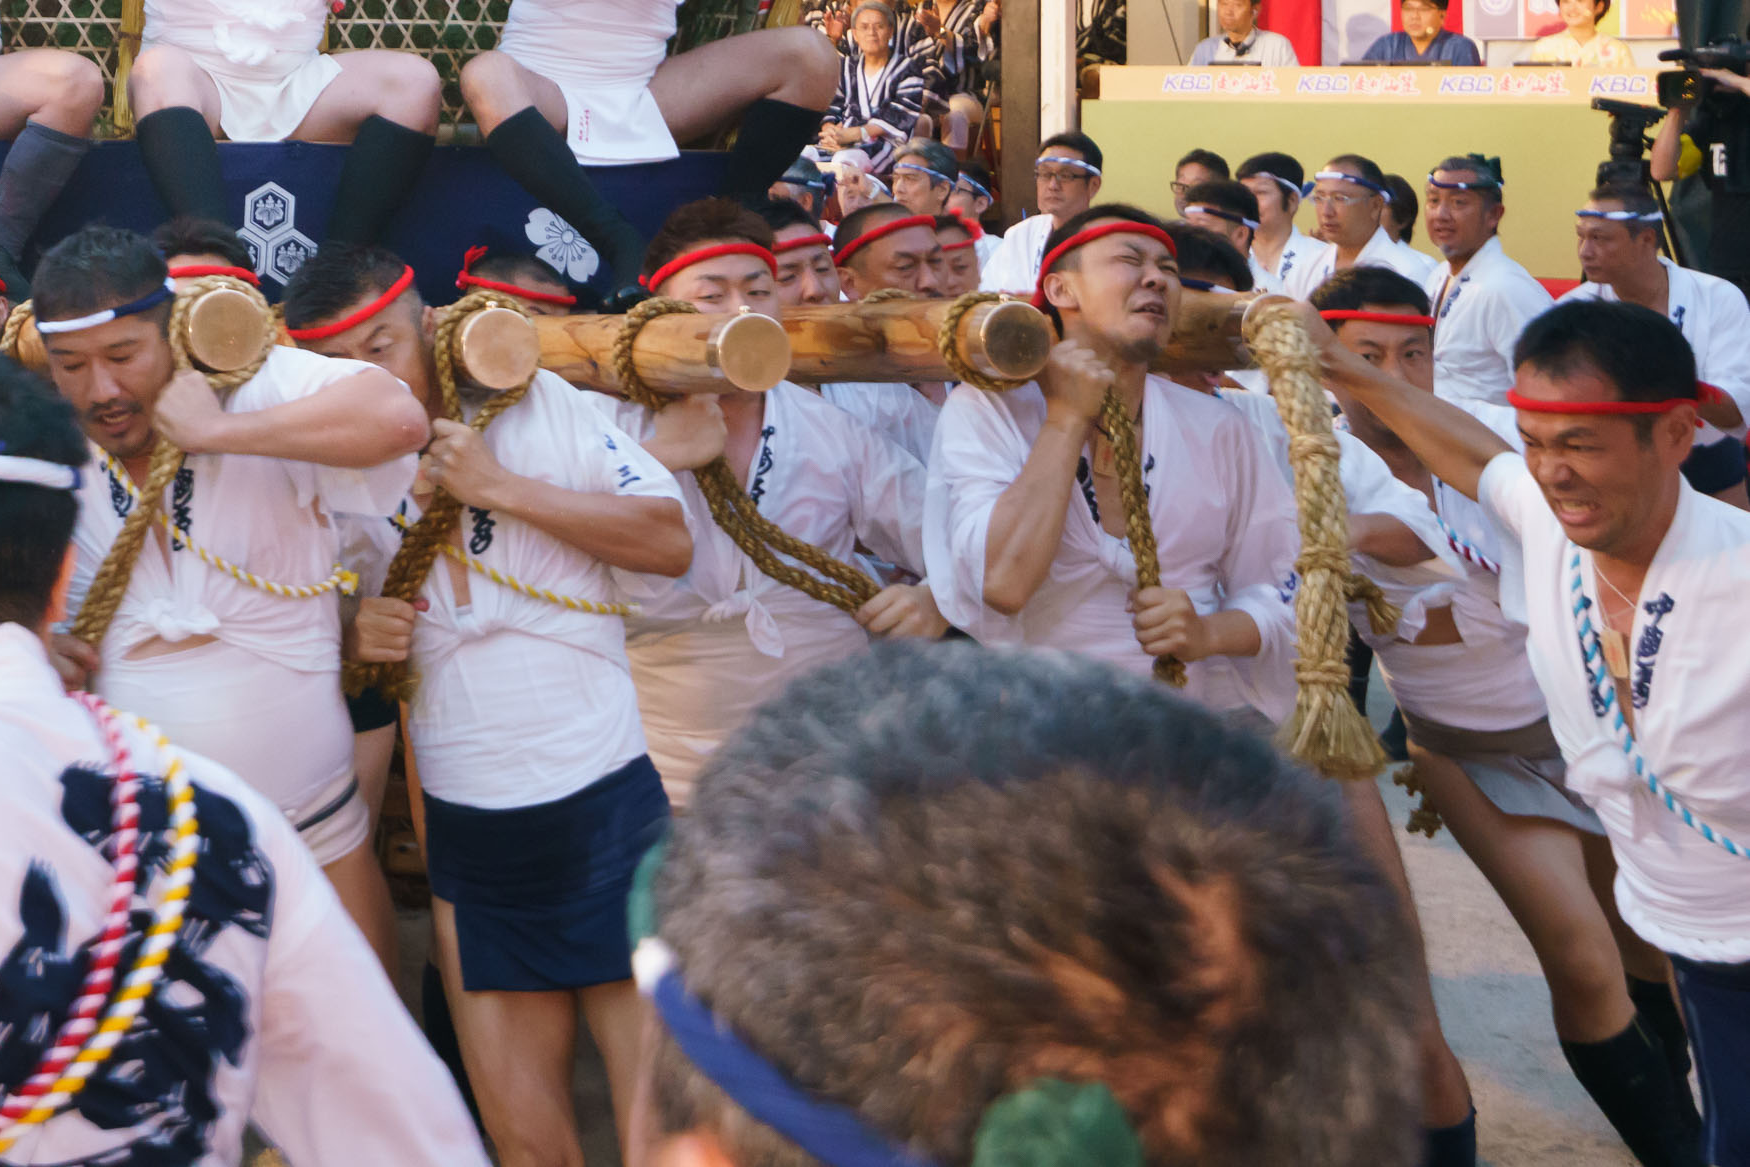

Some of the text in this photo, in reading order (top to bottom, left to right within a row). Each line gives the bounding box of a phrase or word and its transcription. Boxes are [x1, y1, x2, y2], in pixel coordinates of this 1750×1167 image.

[1164, 74, 1211, 90] KBC
[1298, 74, 1348, 91] KBC
[1440, 75, 1492, 92] KBC
[1590, 75, 1646, 92] KBC
